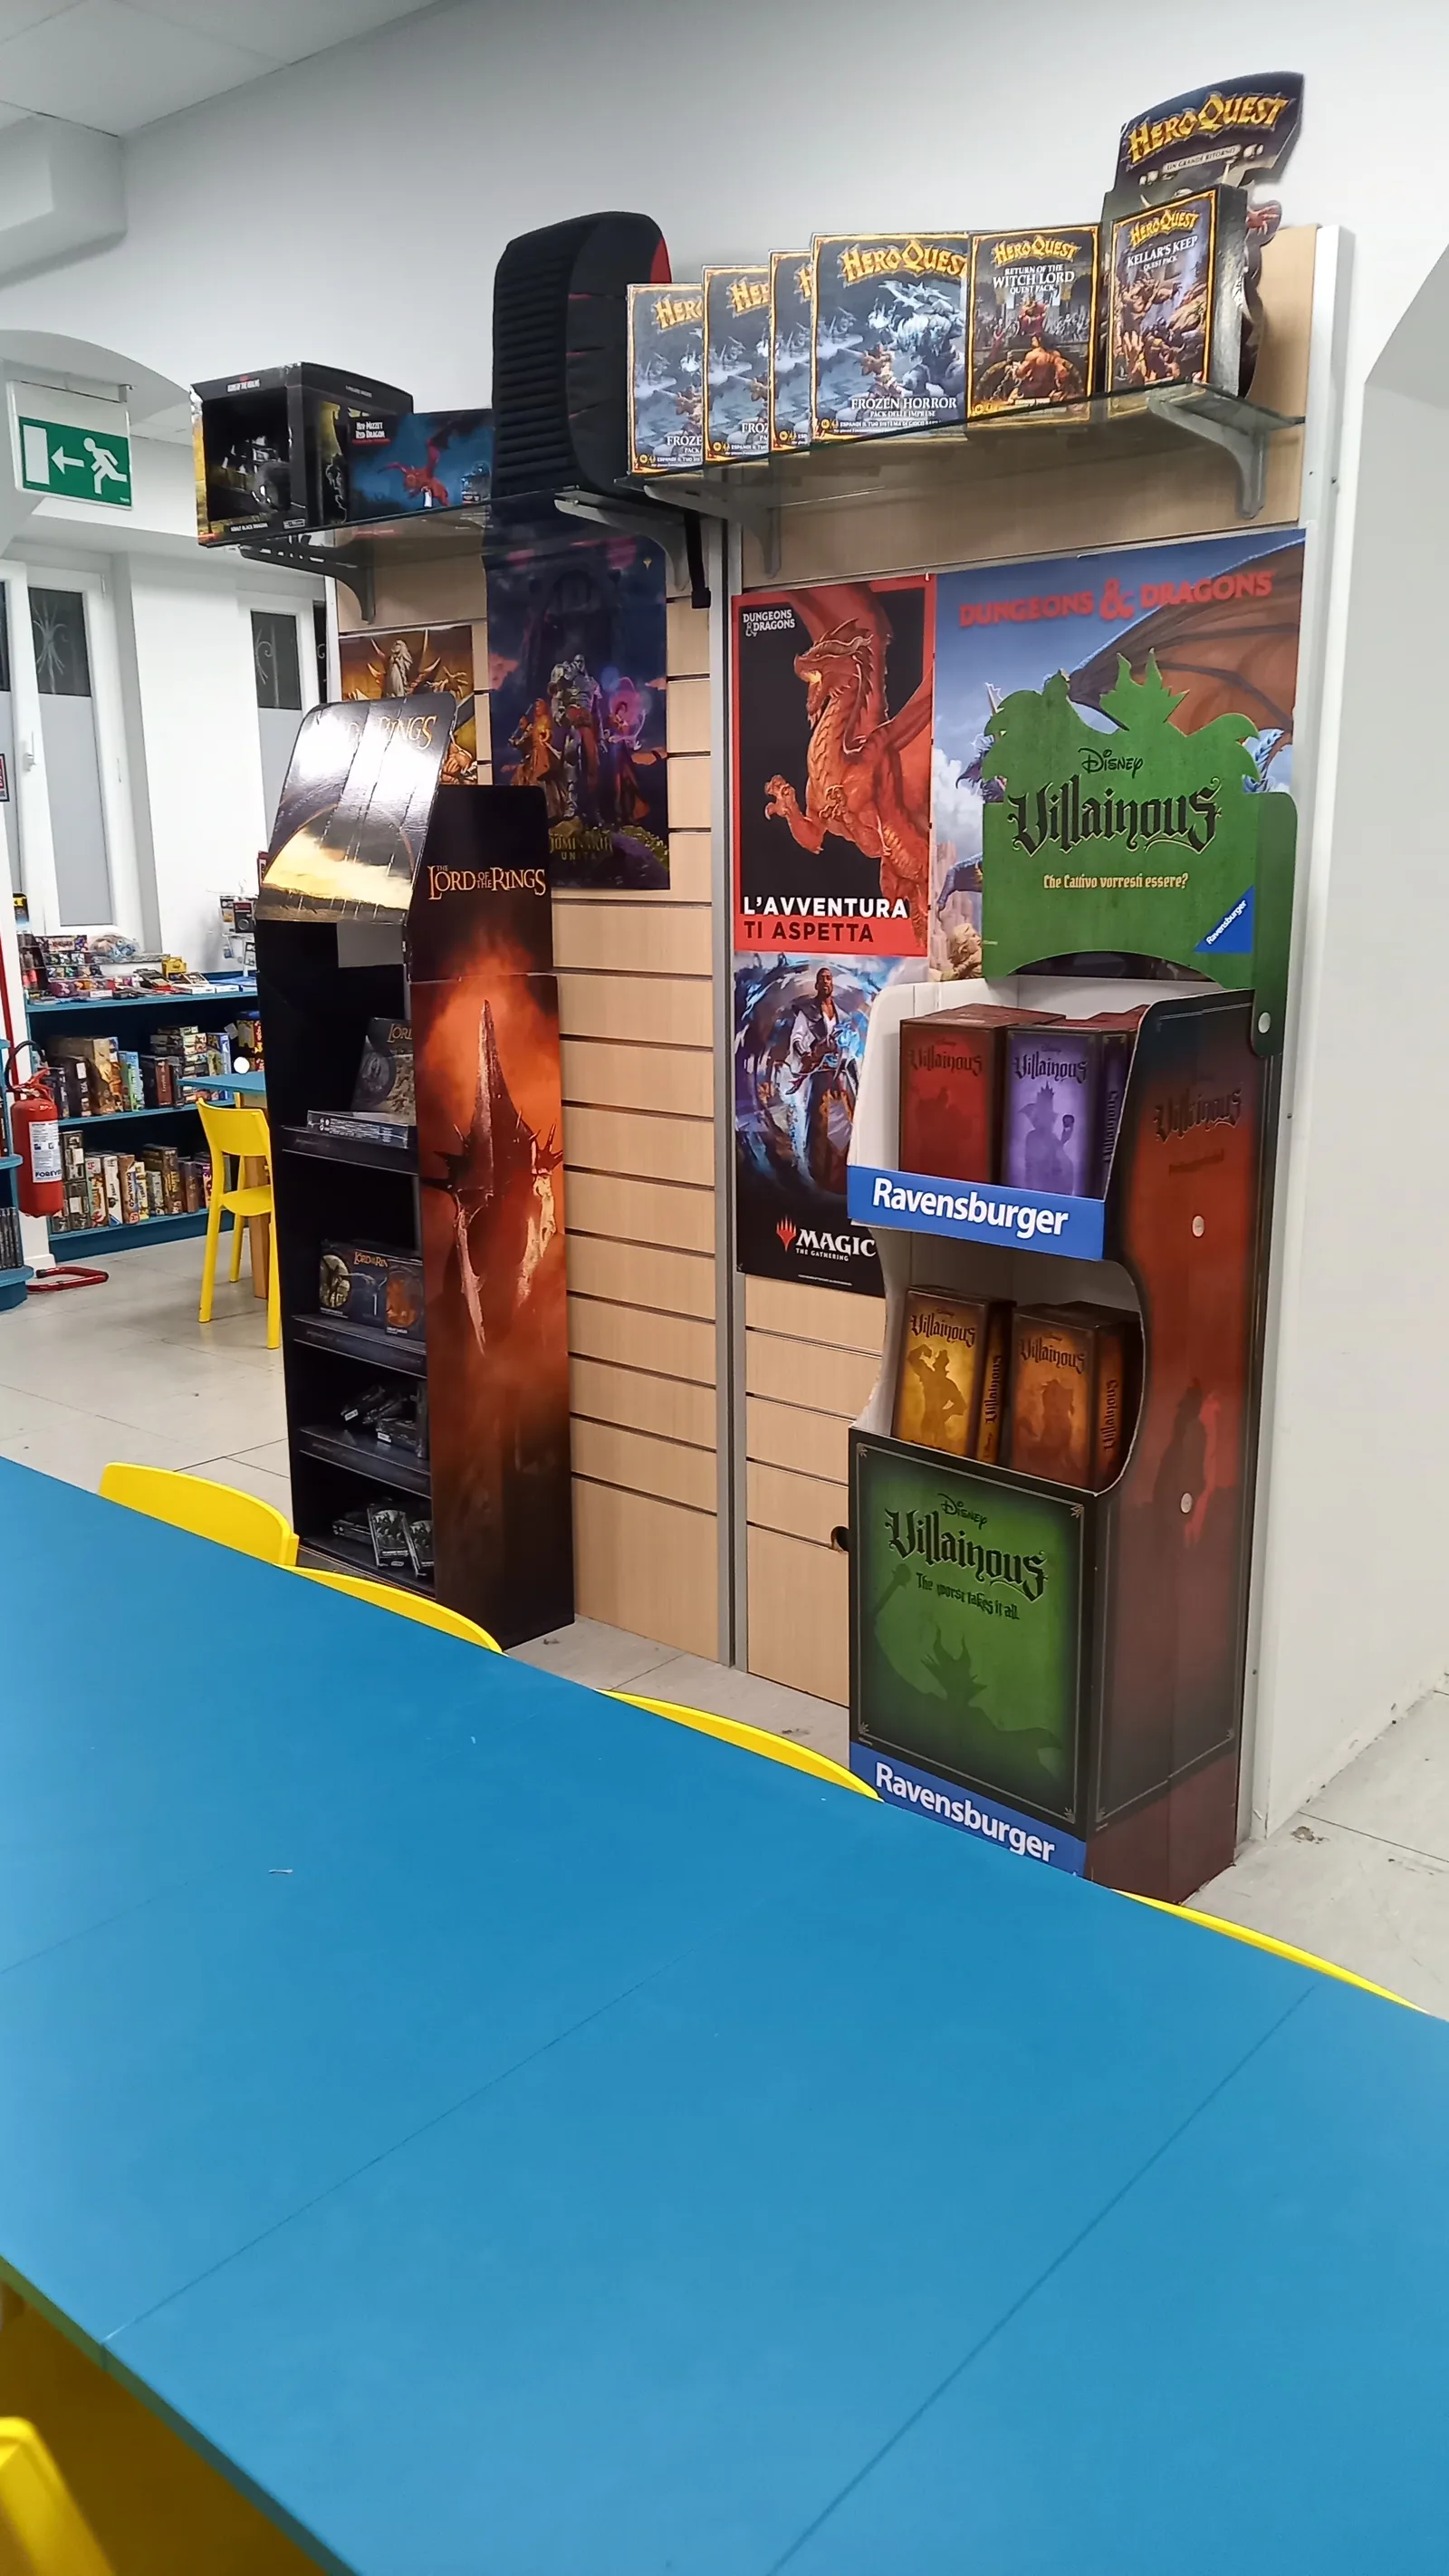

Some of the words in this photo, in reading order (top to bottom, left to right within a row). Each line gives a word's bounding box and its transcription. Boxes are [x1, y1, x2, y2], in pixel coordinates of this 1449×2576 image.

[1127, 245, 1170, 268] KELLAR'S
[1172, 235, 1197, 255] KEEP
[1143, 260, 1162, 272] QUEST
[1163, 255, 1178, 266] PACK
[993, 274, 1036, 289] WITCH
[1039, 270, 1075, 284] LORD
[1005, 265, 1035, 275] RETURN
[1036, 264, 1045, 273] OF
[1046, 264, 1063, 273] THE
[1010, 285, 1034, 294] QUEST
[1035, 284, 1055, 293] PACK
[851, 398, 900, 409] FROZEN
[904, 397, 956, 409] HORROR
[959, 591, 1093, 628] DUNGEONS
[1099, 577, 1135, 620] &
[1140, 571, 1274, 610] DRAGONS
[743, 610, 792, 623] DUNGEONS
[753, 619, 795, 631] DRAGONS
[1007, 774, 1223, 857] Villainous
[427, 865, 476, 900] LORD
[476, 879, 492, 889] THE
[477, 871, 489, 880] OF
[490, 867, 546, 896] RINGS
[1044, 874, 1062, 889] Che
[1064, 872, 1098, 889] Cattivo
[1099, 872, 1143, 889] vorresti
[1145, 872, 1189, 889] essere?
[744, 896, 908, 918] L'AVVENTURA
[744, 921, 763, 938] TI
[772, 921, 874, 942] ASPETTA
[1205, 899, 1247, 945] Ravensburger
[908, 1044, 984, 1077] Villainous
[1012, 1051, 1088, 1084] Villainous
[872, 1177, 1069, 1239] Ravensburger
[795, 1247, 809, 1255] THE
[811, 1249, 849, 1262] GATHERING
[796, 1228, 877, 1257] MAGIC
[909, 1312, 976, 1348] Villainous
[1021, 1335, 1086, 1375] Villainous
[1100, 1379, 1118, 1450] Villainous
[885, 1507, 1049, 1602] Villainous
[916, 1572, 933, 1591] The
[967, 1591, 993, 1615] takes
[876, 1761, 1055, 1862] Ravensburger
